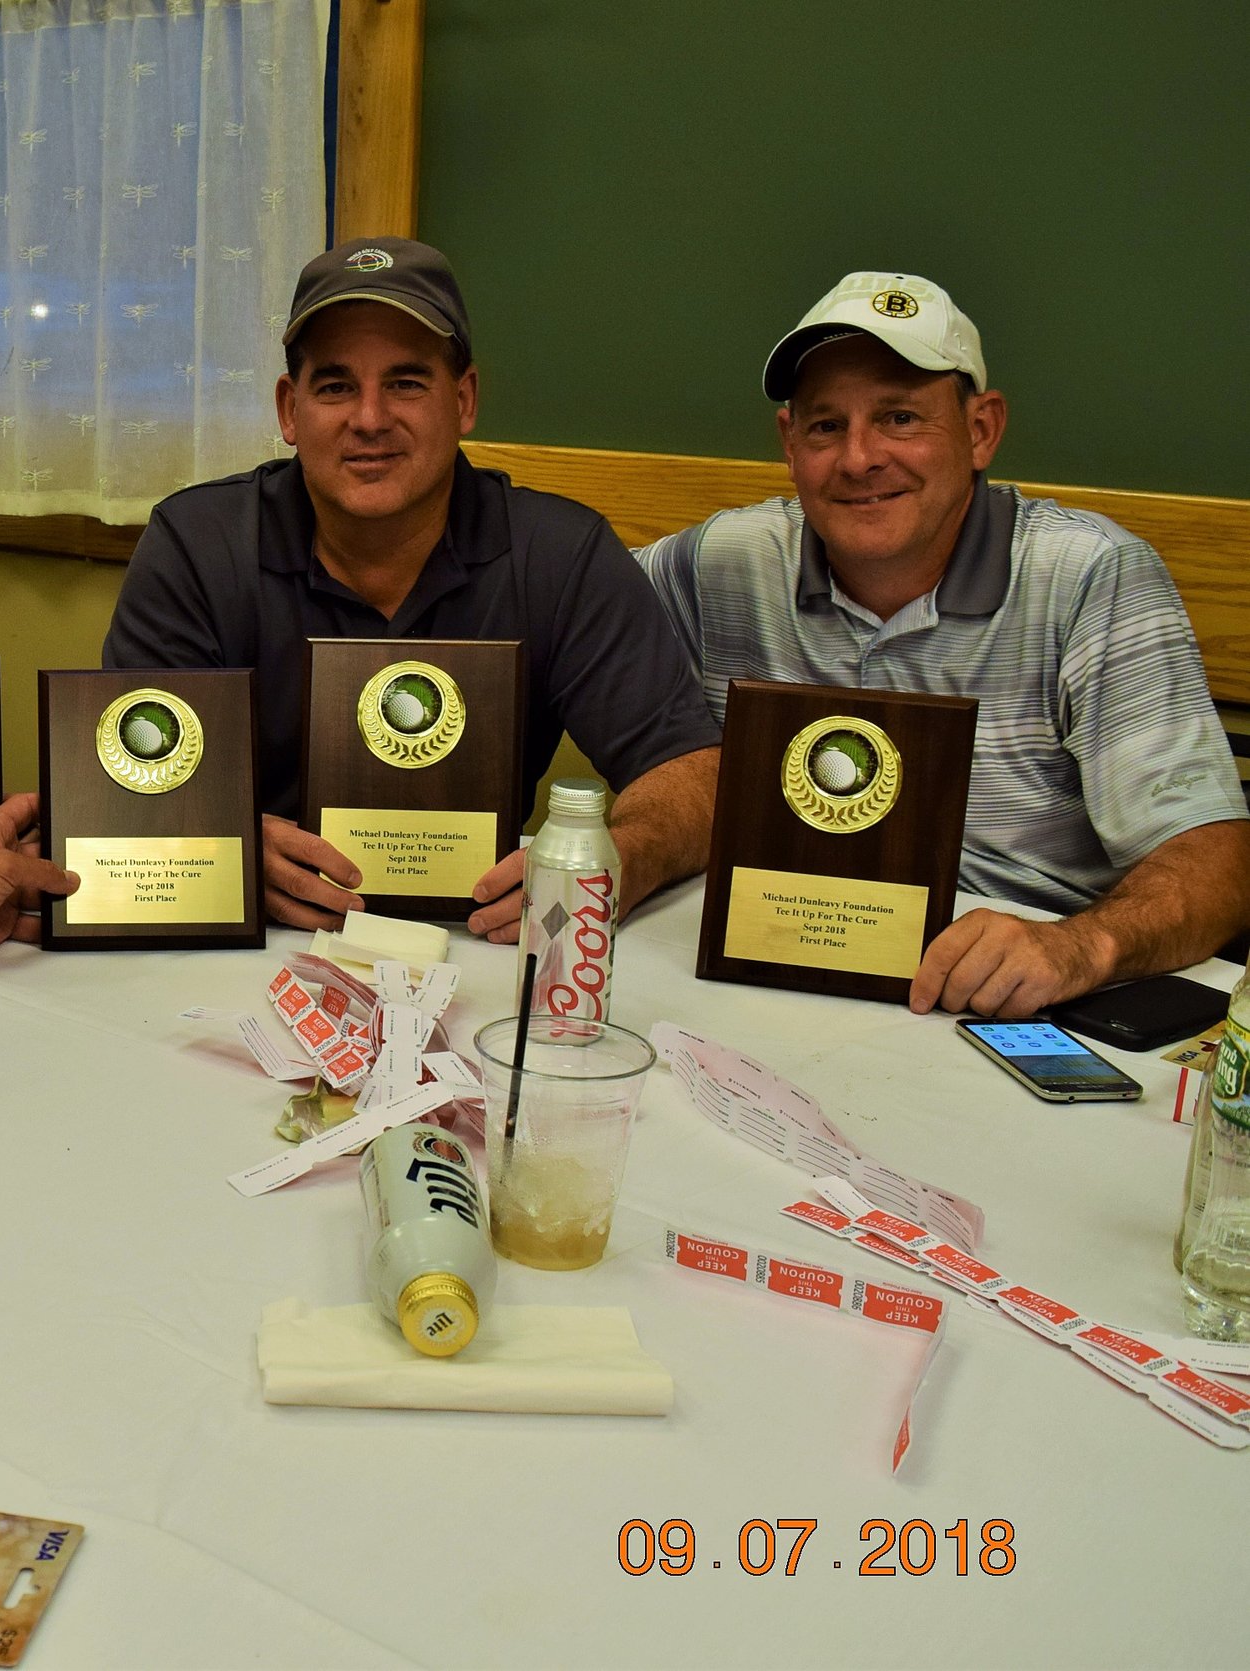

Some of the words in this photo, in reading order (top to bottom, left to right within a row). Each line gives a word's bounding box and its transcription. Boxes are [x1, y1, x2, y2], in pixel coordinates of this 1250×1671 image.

[886, 295, 908, 312] B
[349, 829, 381, 838] Michael
[383, 830, 420, 841] Dunleavy
[422, 831, 468, 841] Foundation
[361, 842, 376, 850] Tee
[377, 842, 385, 850] It
[386, 842, 399, 852] Up
[400, 843, 415, 851] For
[416, 843, 433, 852] The
[434, 844, 455, 852] Cure
[95, 858, 127, 866] Michael
[129, 858, 166, 868] Dunleavy
[168, 858, 215, 866] Foundation
[388, 854, 406, 864] Sept
[407, 855, 427, 863] 2018
[133, 871, 146, 880] Up
[147, 870, 163, 878] For
[163, 870, 180, 878] The
[181, 870, 202, 878] Cure
[386, 866, 406, 875] First
[407, 867, 429, 875] Place
[135, 882, 154, 891] Sept
[155, 882, 175, 890] 2018
[134, 894, 154, 902] First
[155, 894, 177, 902] Place
[761, 892, 797, 904] Michael
[799, 896, 841, 909] Dunleavy
[842, 900, 894, 915] Foundation
[774, 906, 790, 916] Tee
[792, 908, 800, 917] It
[801, 909, 815, 920] Up
[817, 911, 834, 921] For
[835, 912, 853, 924] The
[855, 915, 878, 926] Cure
[802, 923, 823, 934] Sept
[824, 925, 846, 935] 2018
[799, 935, 821, 946] First
[822, 937, 847, 949] Place
[547, 868, 614, 1037] Coors
[1173, 1050, 1201, 1063] VISA
[405, 1158, 481, 1229] Lite
[790, 1208, 837, 1227] COUPON
[809, 1206, 838, 1219] KEEP
[862, 1218, 908, 1238] COUPON
[881, 1216, 911, 1229] KEEP
[686, 1241, 740, 1259] COUPON
[864, 1239, 912, 1261] COUPON
[697, 1260, 727, 1272] KEEP
[931, 1253, 980, 1279] COUPON
[952, 1253, 982, 1269] KEEP
[779, 1266, 835, 1285] COUPON
[789, 1285, 821, 1298] KEEP
[875, 1290, 933, 1310] COUPON
[1006, 1293, 1056, 1319] COUPON
[1026, 1294, 1059, 1309] KEEP
[426, 1312, 455, 1337] Lite
[885, 1311, 919, 1324] KEEP
[1086, 1334, 1141, 1359] COUPON
[1108, 1333, 1142, 1348] KEEP
[1172, 1377, 1230, 1409] COUPON
[1195, 1378, 1231, 1398] KEEP
[35, 1529, 70, 1562] VISA
